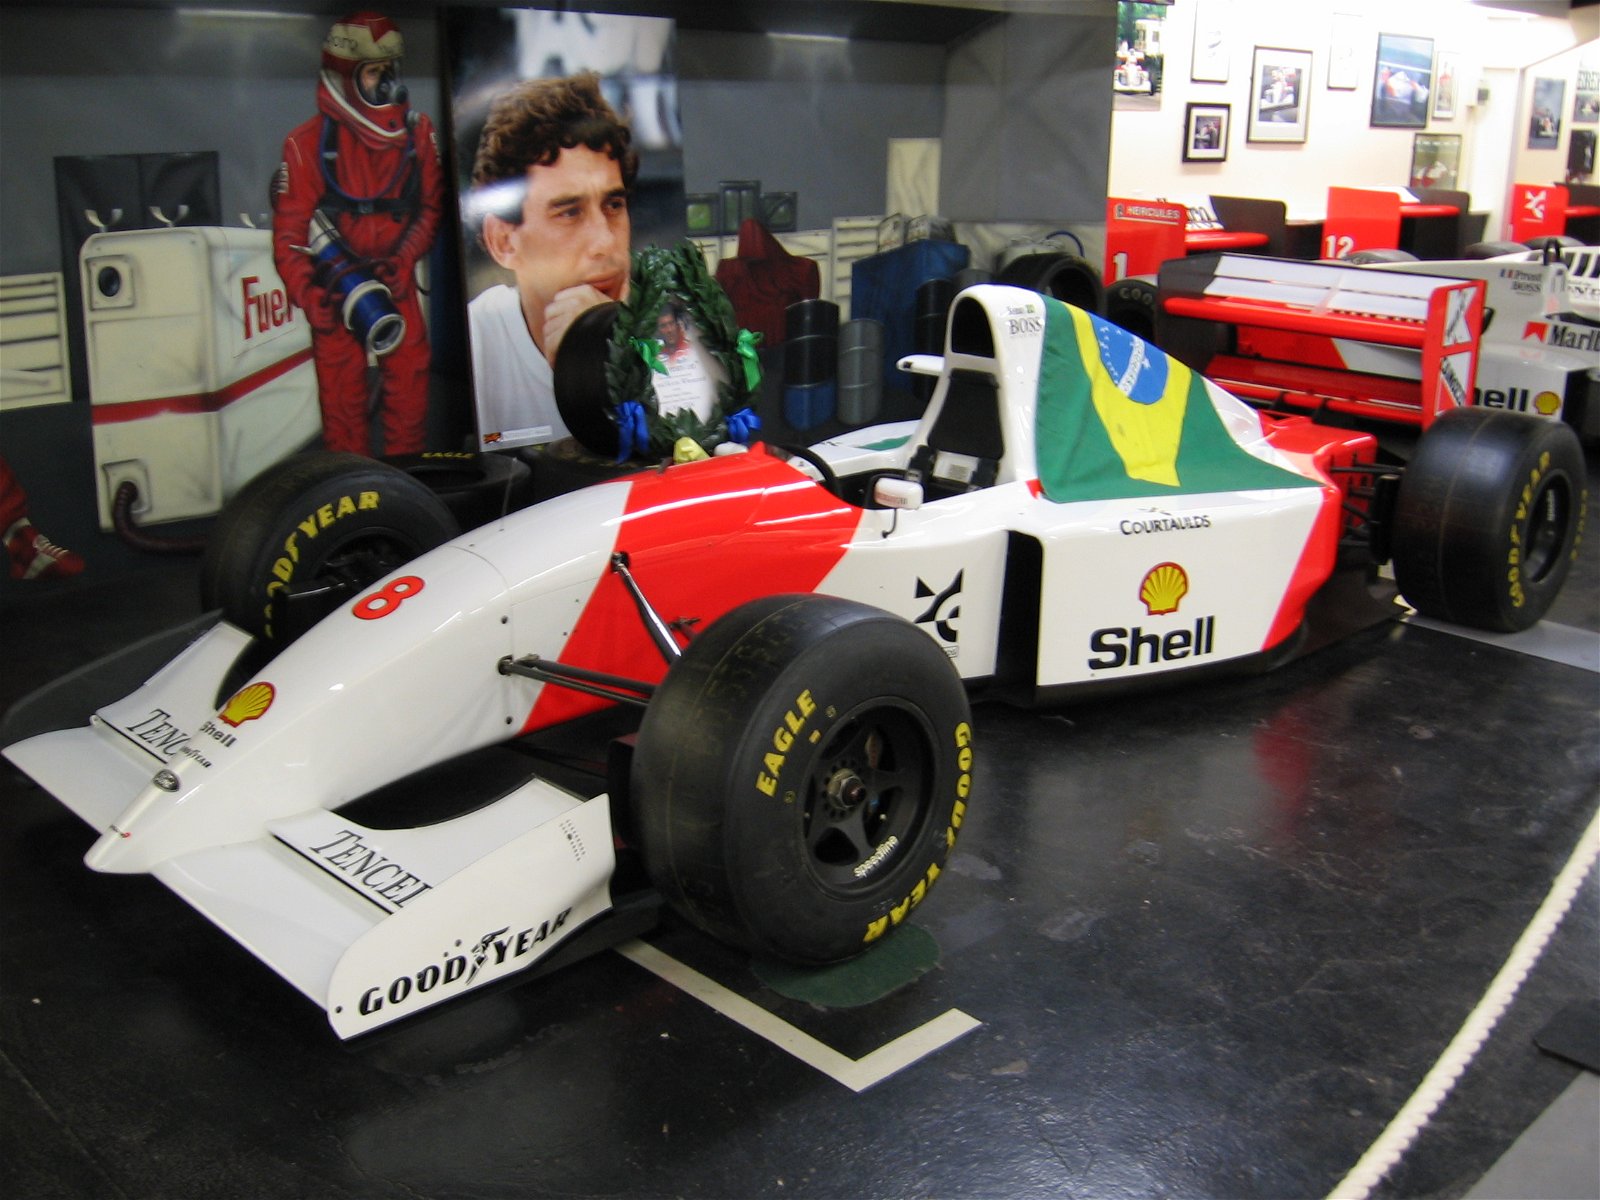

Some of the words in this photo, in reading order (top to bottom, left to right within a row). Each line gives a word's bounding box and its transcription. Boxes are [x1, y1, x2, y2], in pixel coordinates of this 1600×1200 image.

[1325, 235, 1354, 259] 12
[1113, 252, 1128, 281] 1
[1009, 317, 1043, 335] BOSS
[1473, 387, 1529, 412] ell
[353, 575, 426, 620] 8
[1087, 615, 1215, 670] Shell
[200, 721, 238, 747] Shell
[756, 689, 817, 797] EAGLE
